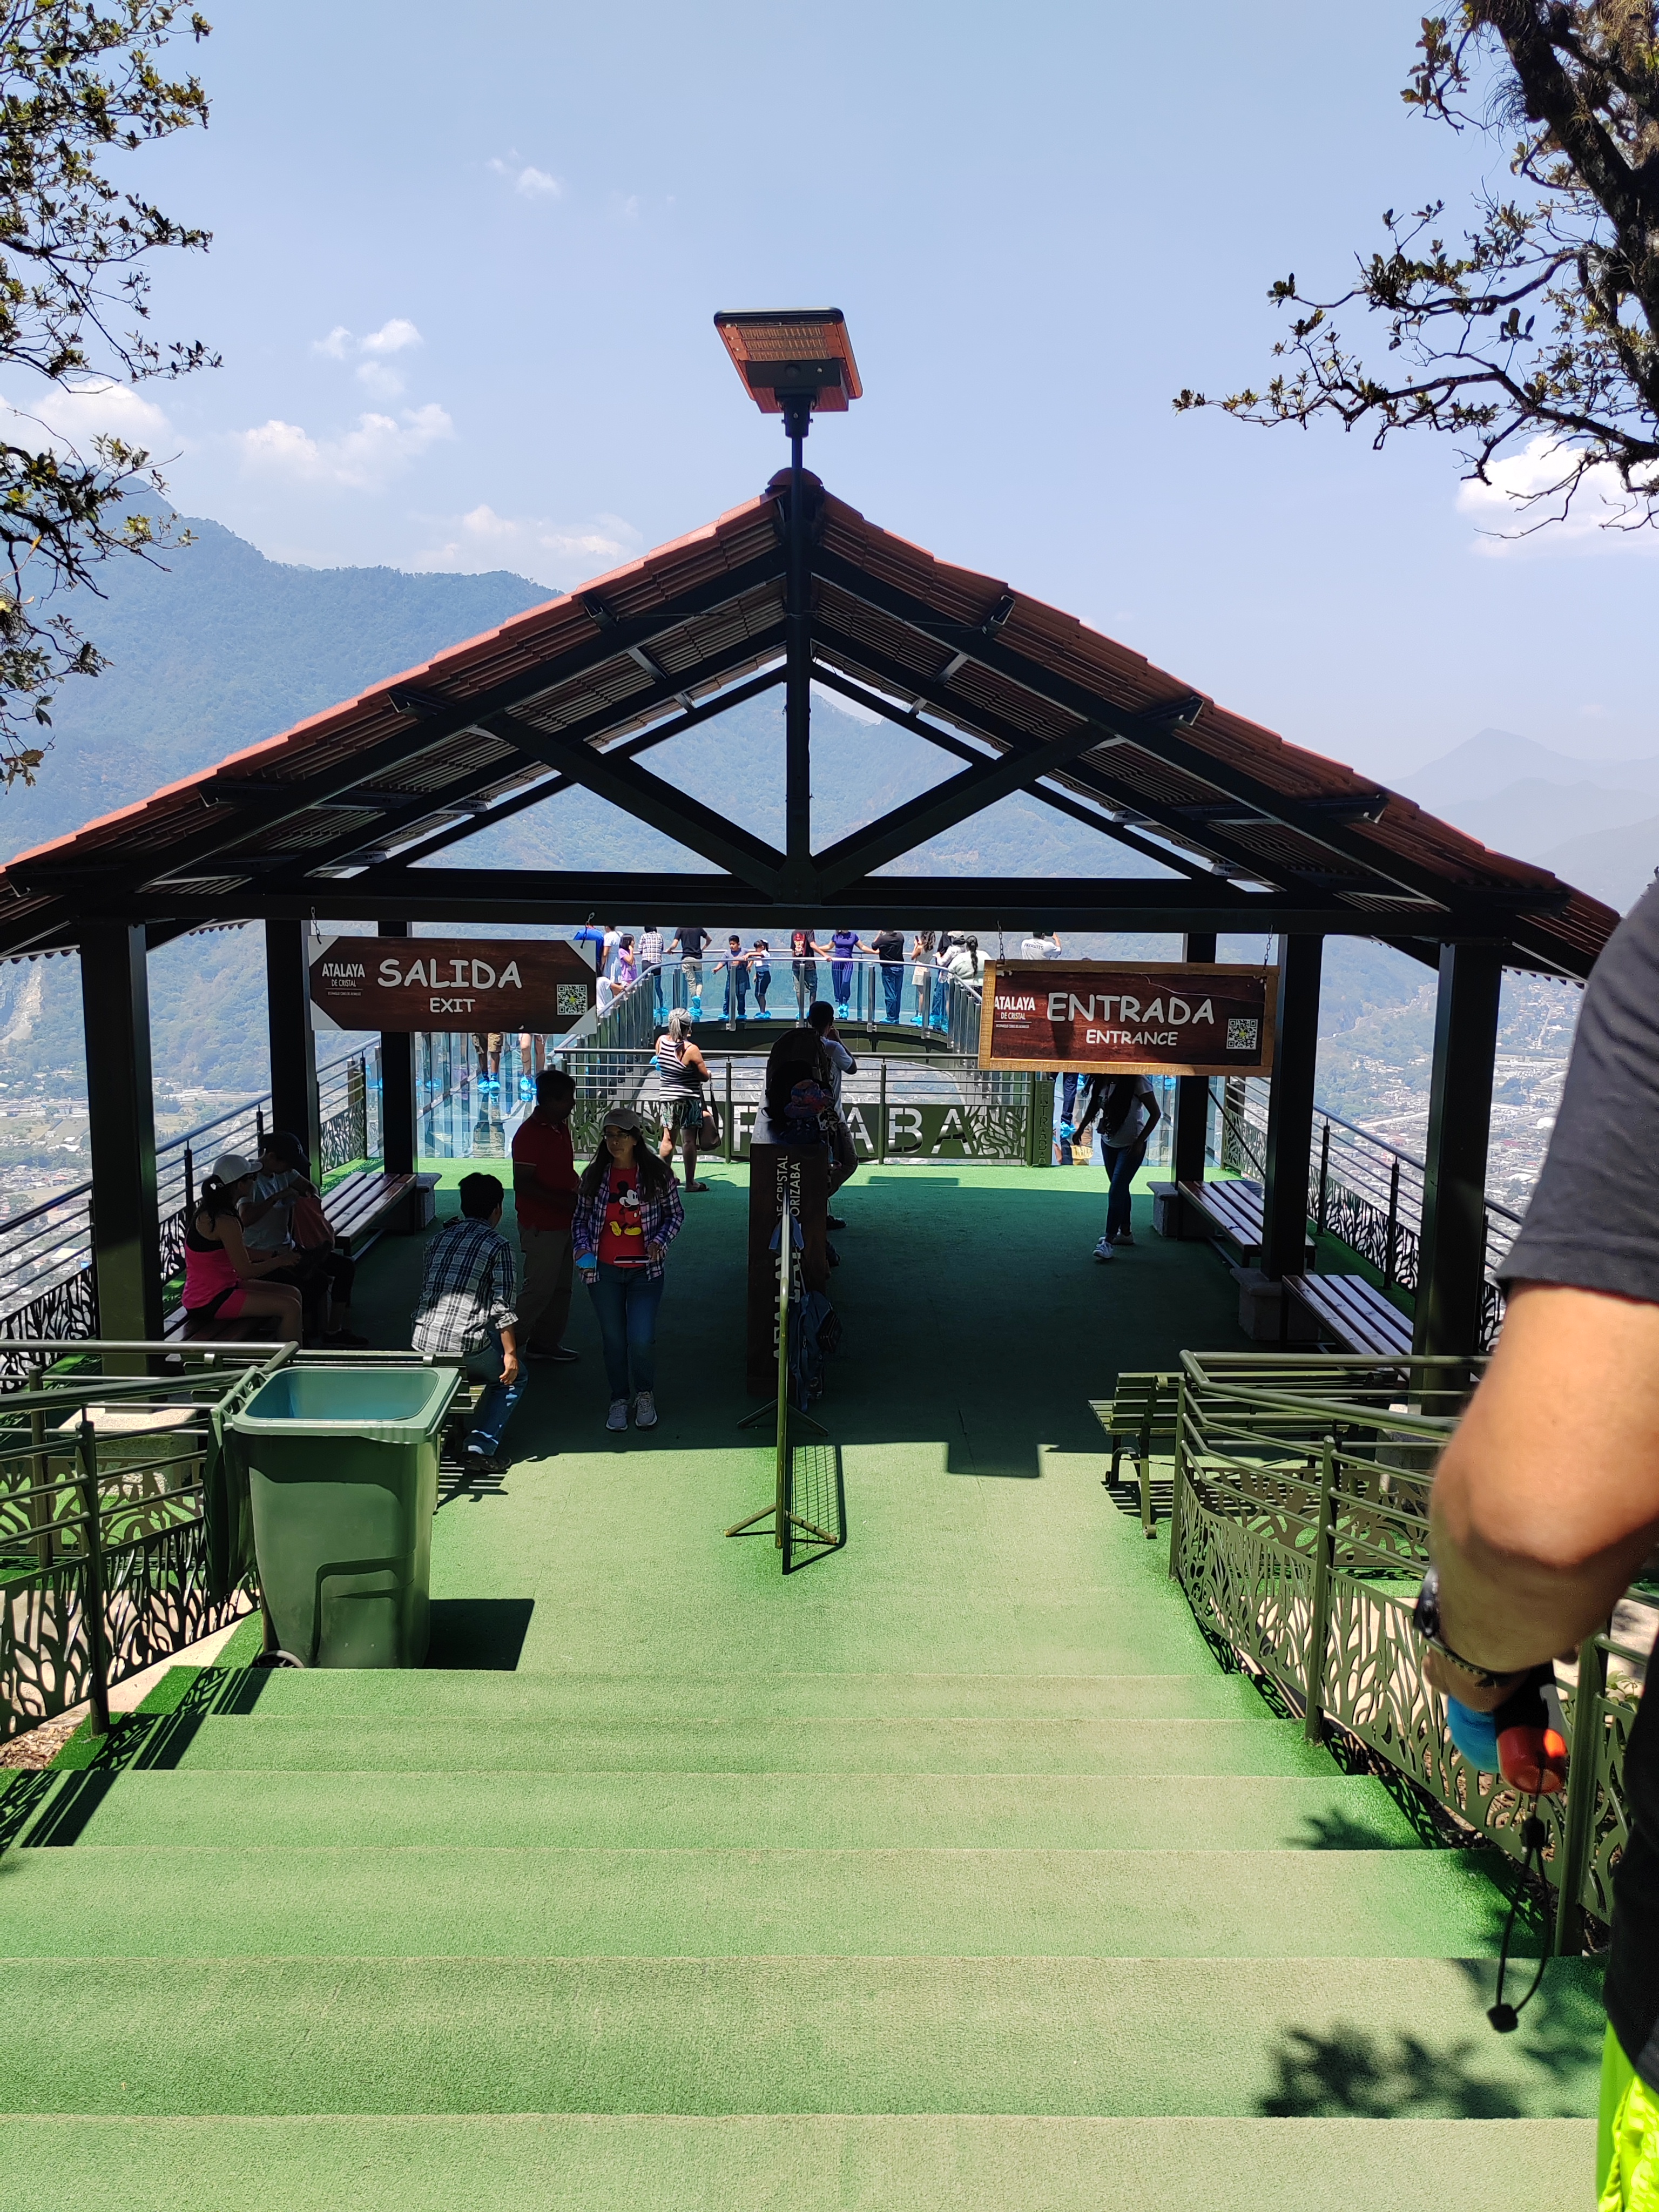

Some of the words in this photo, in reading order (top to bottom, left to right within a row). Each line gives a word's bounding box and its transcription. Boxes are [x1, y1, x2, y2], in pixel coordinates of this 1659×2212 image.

[321, 963, 366, 977] ATALAYA
[377, 958, 522, 989] SALIDA
[331, 979, 338, 987] DE
[339, 979, 356, 987] CRISTAL
[430, 997, 476, 1013] EXIT
[994, 996, 1036, 1011] ATALAYA
[1047, 992, 1215, 1025] ENTRADA
[1001, 1011, 1008, 1020] DE
[1008, 1012, 1026, 1020] CRISTAL
[1085, 1029, 1178, 1046] ENTRANCE
[790, 1162, 801, 1217] ORIZABA
